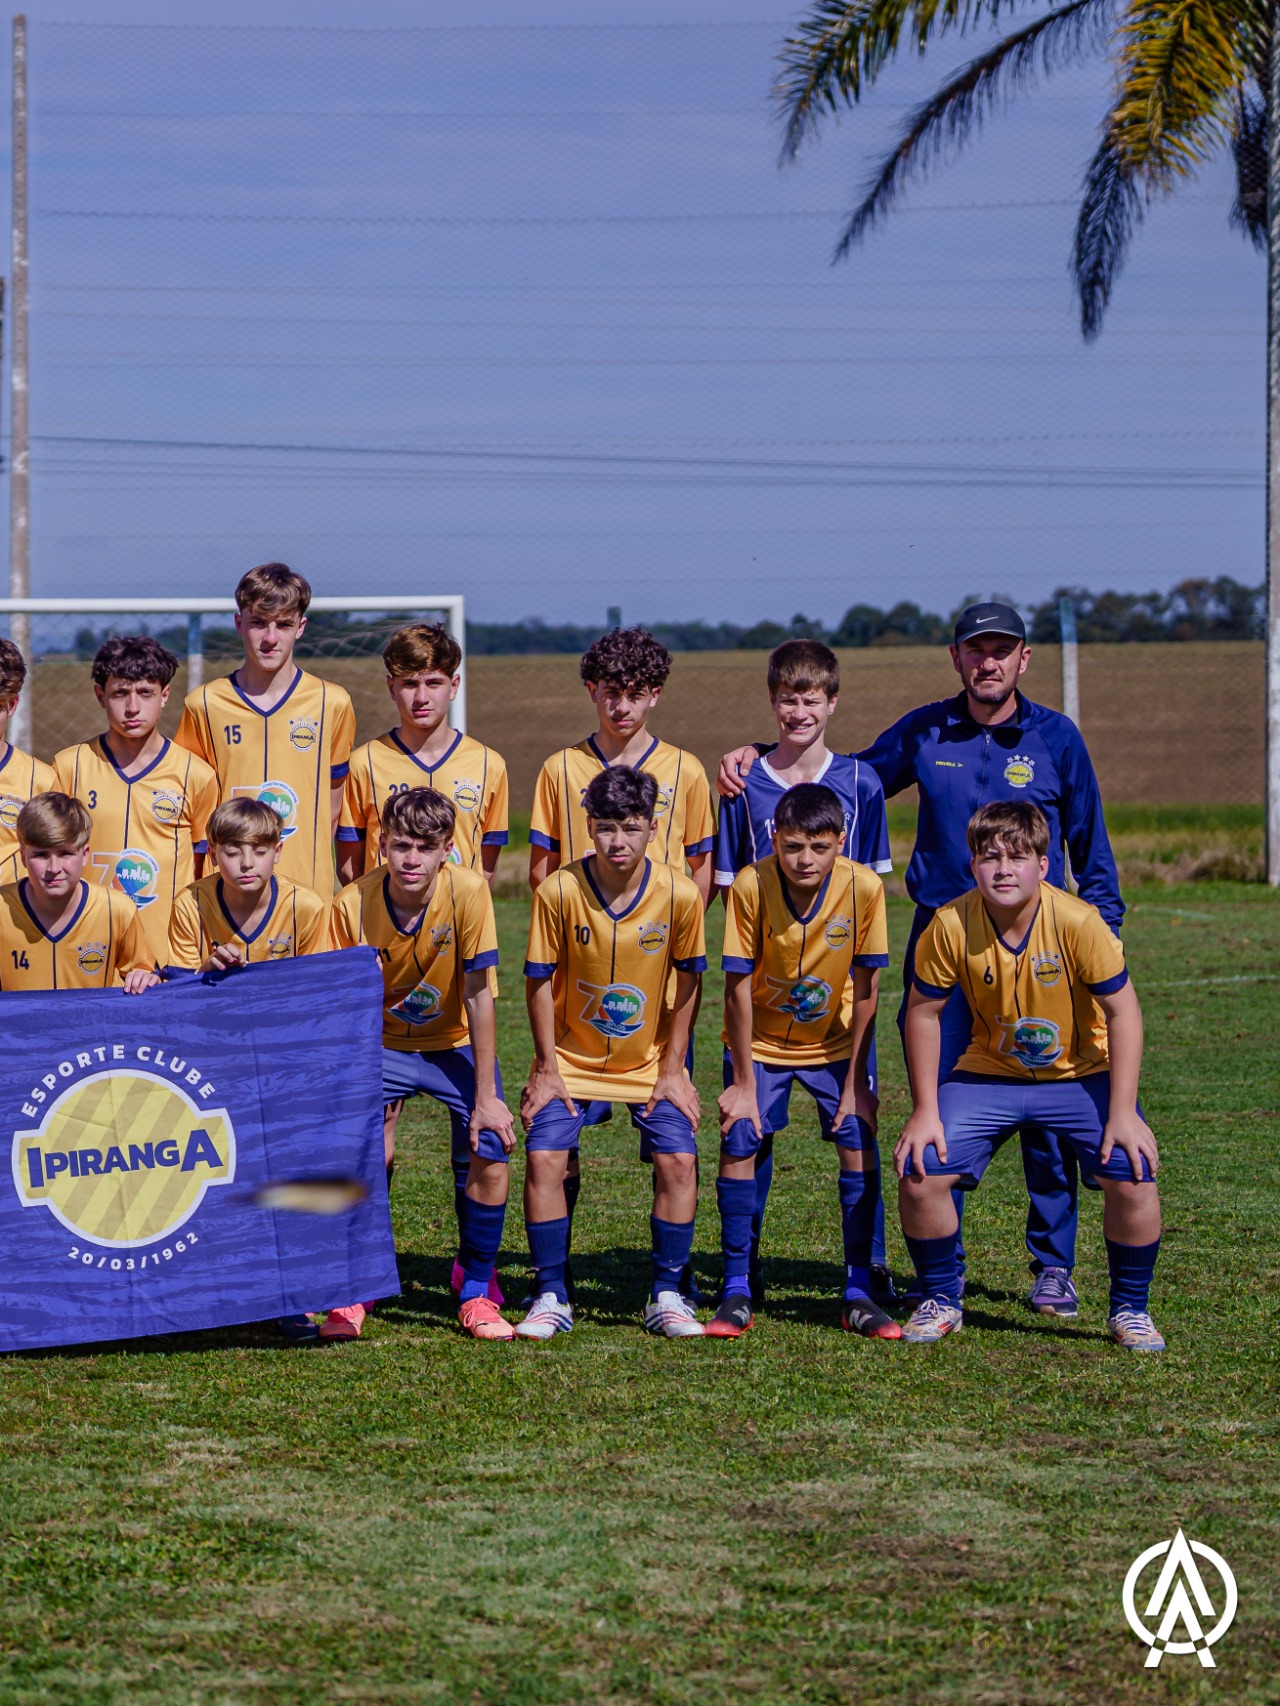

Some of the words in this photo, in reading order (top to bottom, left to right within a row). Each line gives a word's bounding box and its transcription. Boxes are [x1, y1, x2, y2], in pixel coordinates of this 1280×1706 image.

[223, 724, 242, 746] 15
[88, 789, 98, 810] 3
[574, 924, 591, 946] 10
[11, 949, 30, 971] 14
[983, 965, 994, 986] 6
[605, 1021, 627, 1031] anos
[21, 1044, 125, 1118] ESPORTE
[136, 1046, 216, 1100] CLUBE
[26, 1128, 225, 1188] IPIRANGA
[67, 1231, 199, 1271] 20/03/1962
